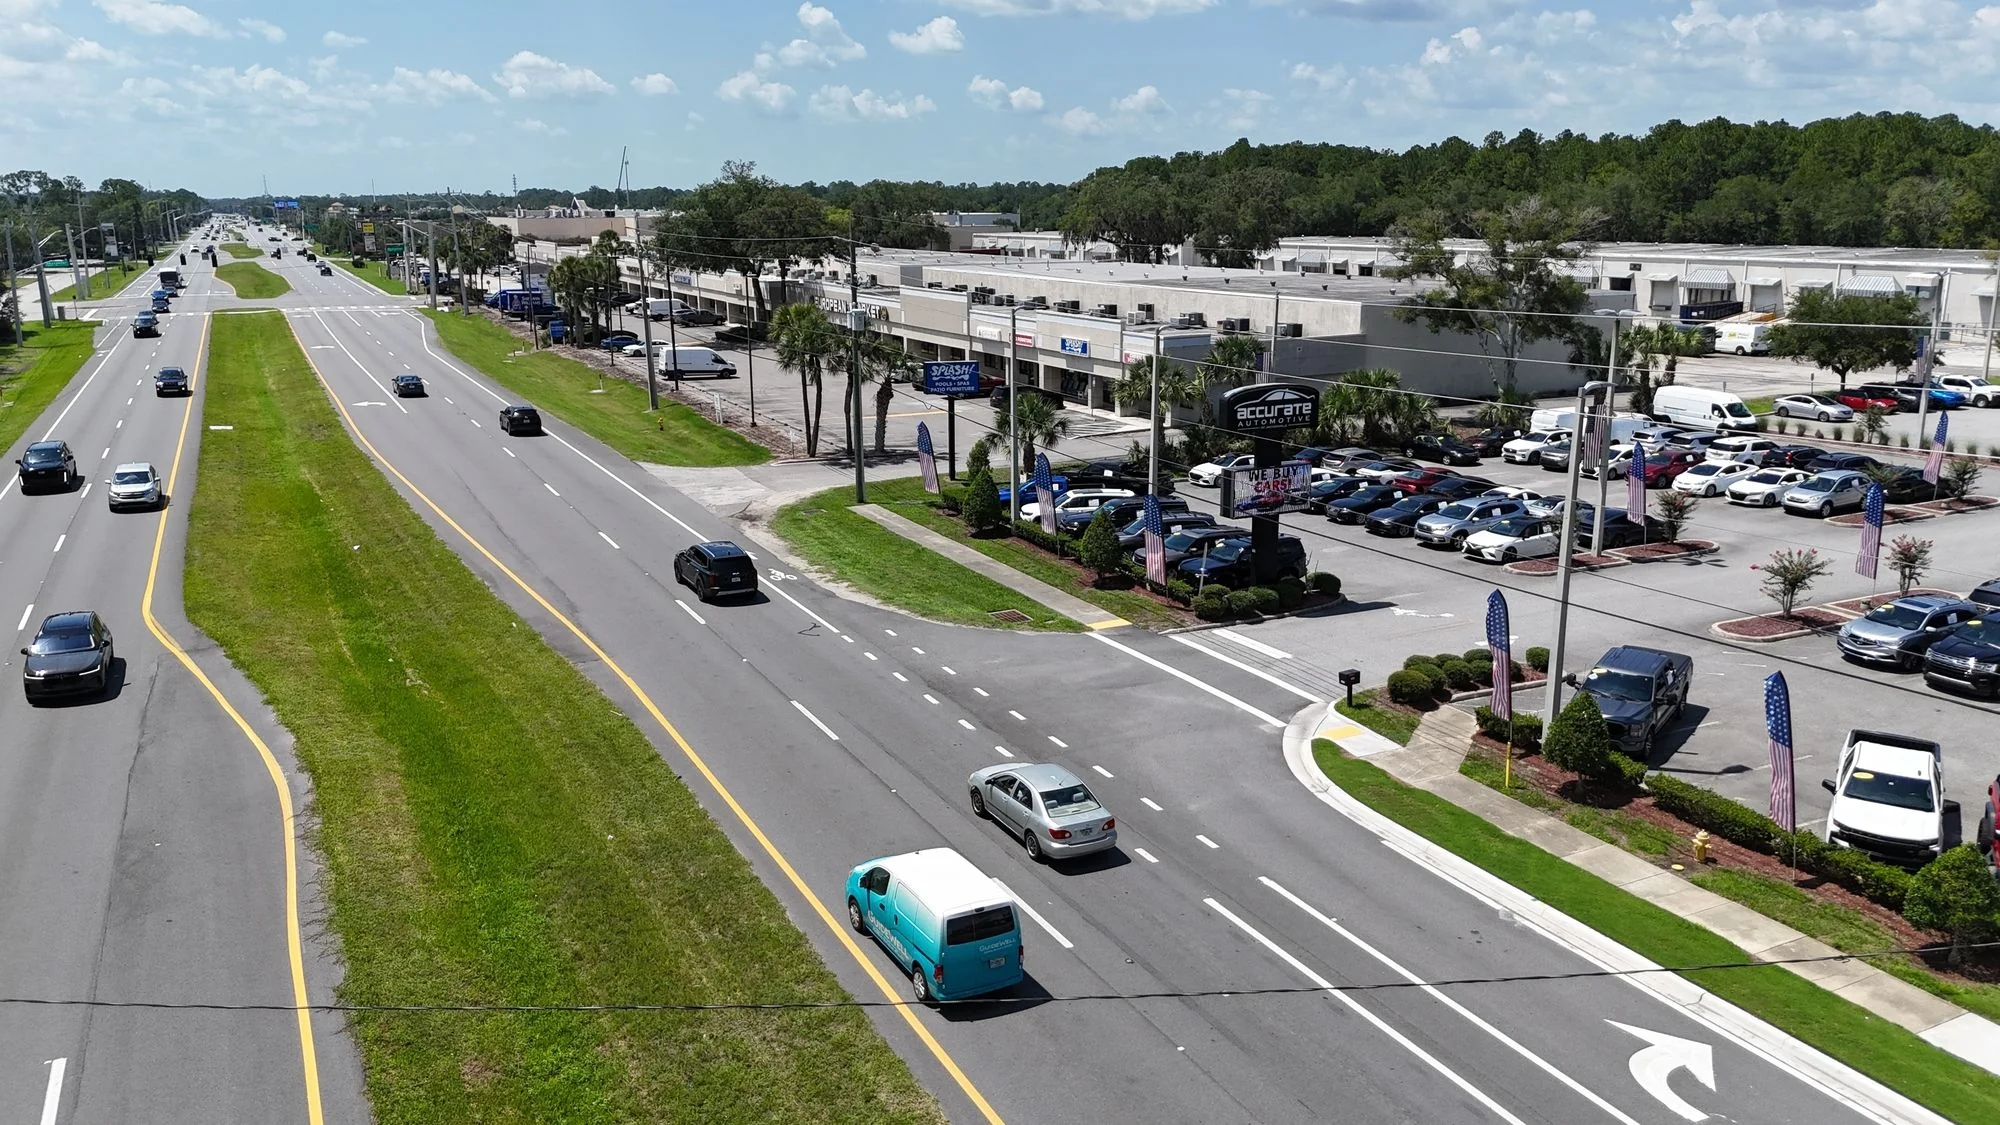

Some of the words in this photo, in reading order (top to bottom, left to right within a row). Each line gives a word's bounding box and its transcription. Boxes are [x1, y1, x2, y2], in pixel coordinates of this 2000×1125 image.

[814, 296, 847, 314] EUROPEAN
[931, 364, 976, 376] SPLASH!
[1237, 415, 1311, 428] AUTOMOTIVE
[1249, 469, 1269, 481] WE
[1273, 465, 1298, 479] BUY
[1254, 478, 1293, 493] CARS!
